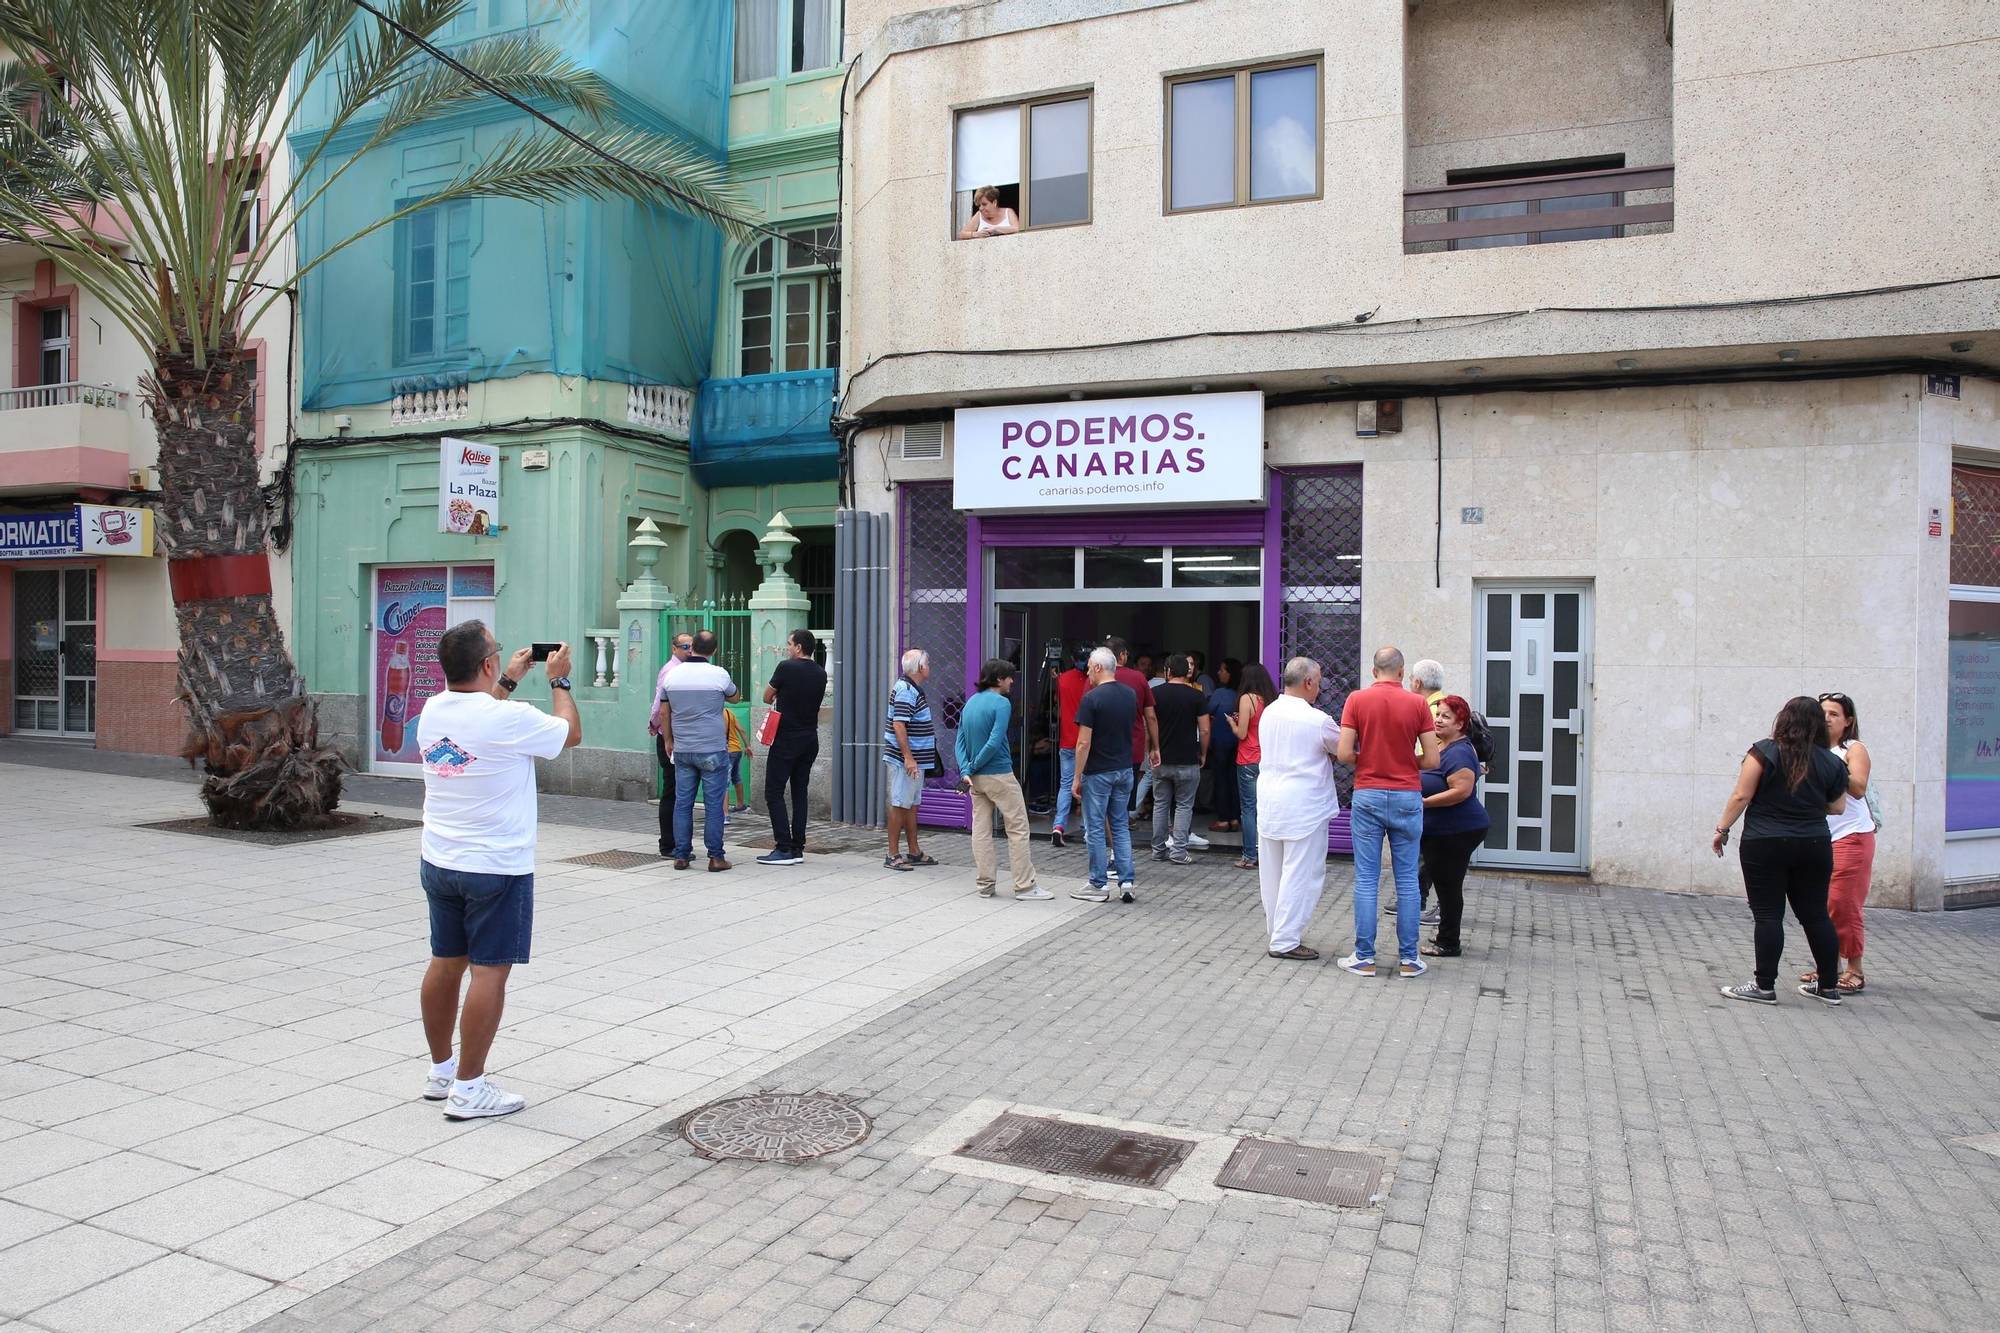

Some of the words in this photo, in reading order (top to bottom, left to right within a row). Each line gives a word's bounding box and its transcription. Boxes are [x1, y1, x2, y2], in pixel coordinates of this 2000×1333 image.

[1935, 382, 1954, 397] PILAR
[1002, 412, 1205, 449] PODEMOS.
[461, 446, 491, 466] Kalise
[1002, 448, 1205, 480] CANARIAS
[481, 478, 497, 486] Bazar
[1039, 481, 1165, 496] canarias.podemos.info
[450, 482, 463, 495] La
[469, 484, 497, 499] Plaza
[1466, 508, 1478, 522] 22
[29, 548, 67, 556] MANTENIMIENTO
[384, 581, 408, 592] Bazar
[409, 580, 419, 591] La
[421, 579, 445, 591] Plaza
[383, 601, 421, 636] Clipper
[415, 641, 438, 649] Golosin
[1956, 653, 1990, 665] igualdad
[415, 665, 427, 673] Pan
[415, 677, 436, 685] snacks
[415, 689, 435, 698] Tabaco
[1955, 685, 1995, 695] diversidad
[1955, 699, 1995, 710] feminismo
[1977, 740, 1992, 757] Un
